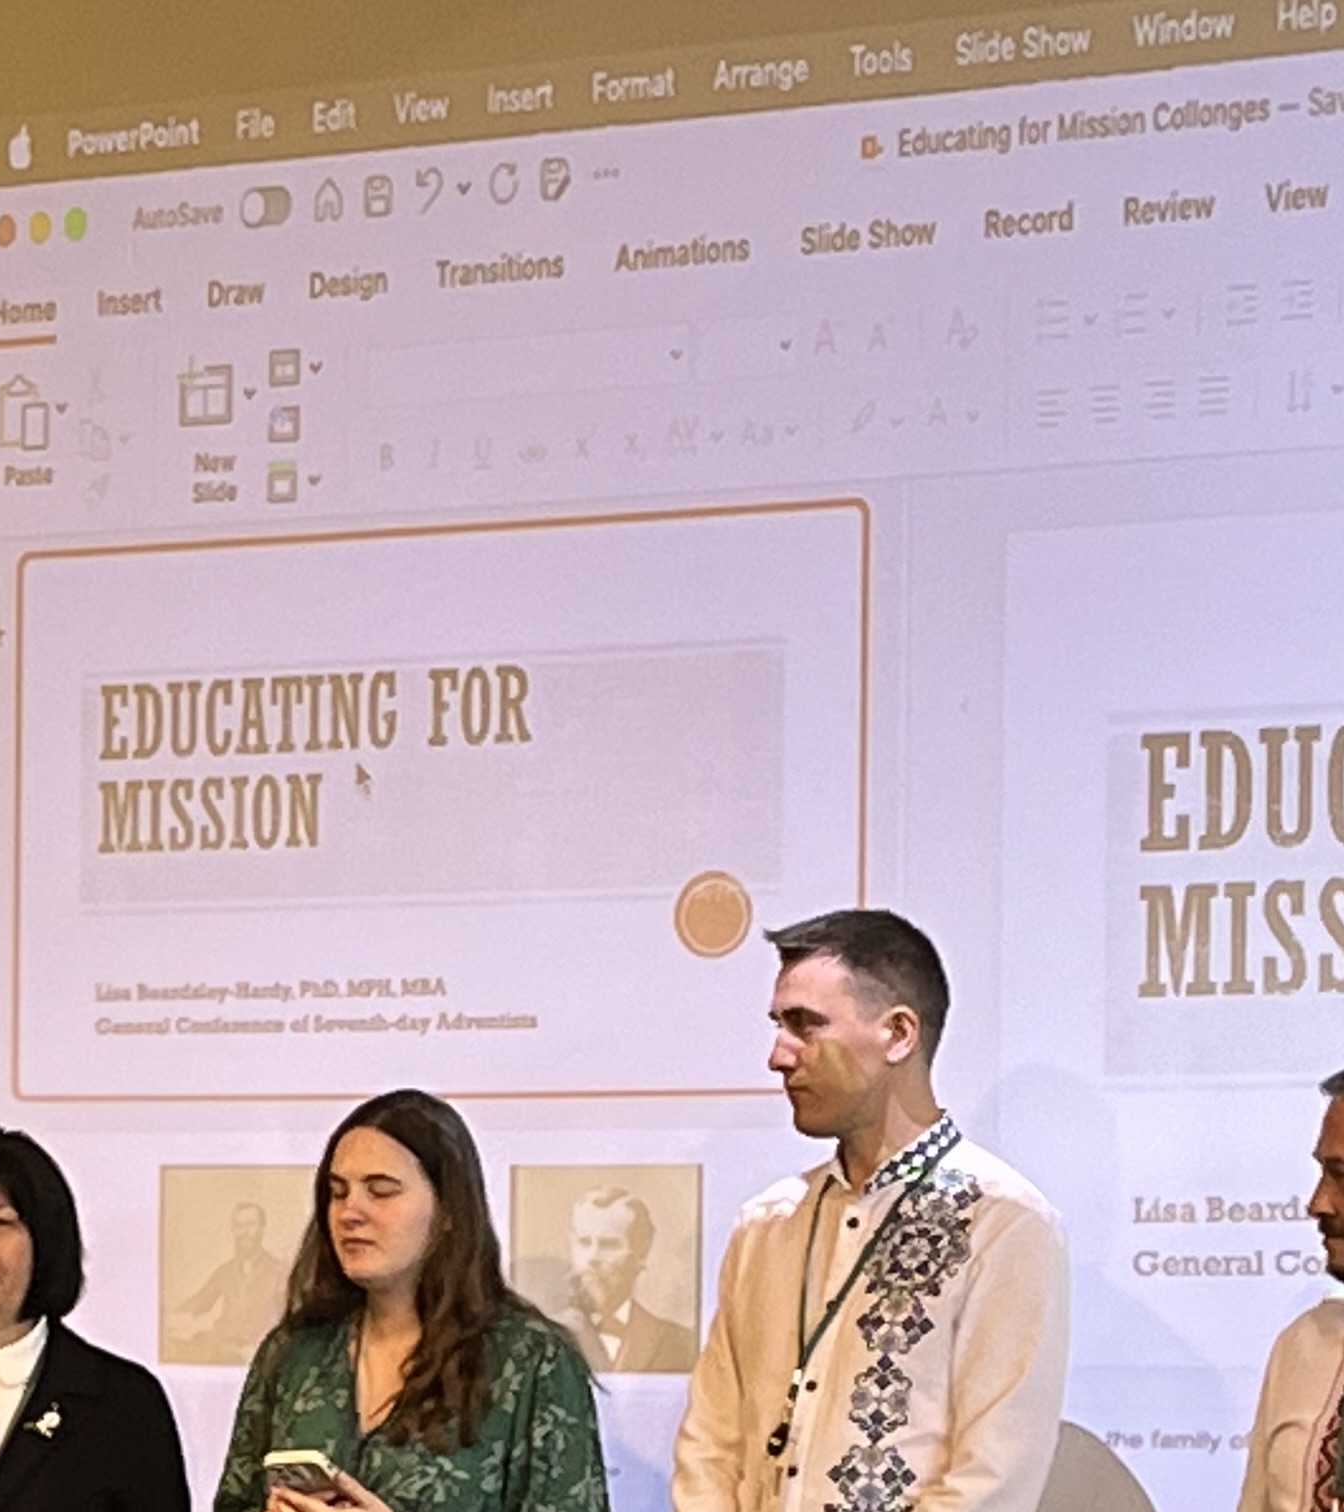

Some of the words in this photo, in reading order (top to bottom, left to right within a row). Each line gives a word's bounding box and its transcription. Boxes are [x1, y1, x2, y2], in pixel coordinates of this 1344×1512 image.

[1132, 11, 1235, 48] Window
[1276, 0, 1337, 33] Help
[849, 40, 913, 76] Tools
[956, 29, 1015, 66] Slide
[1022, 25, 1091, 59] Show
[591, 68, 675, 103] Format
[713, 56, 809, 91] Arrange
[393, 92, 449, 123] View
[487, 80, 553, 115] Insert
[236, 108, 275, 138] File
[312, 100, 357, 133] Edit
[898, 114, 1012, 158] Educating
[1019, 112, 1050, 145] for
[1058, 103, 1146, 141] Mission
[1154, 94, 1270, 133] Collonges
[67, 116, 200, 158] PowerPoint
[1123, 190, 1216, 227] Review
[1265, 179, 1329, 213] View
[132, 199, 224, 231] AutoSave
[984, 202, 1075, 239] Record
[615, 234, 751, 273] Animations
[800, 222, 861, 256] Slide
[867, 216, 936, 251] Show
[309, 268, 388, 302] Design
[436, 252, 564, 289] Transitions
[98, 287, 164, 316] Insert
[208, 279, 265, 308] Draw
[4, 465, 56, 487] Paste
[193, 452, 237, 473] New
[192, 480, 239, 503] Slide
[99, 671, 397, 761] EDUCATING
[429, 663, 533, 748] FOR
[97, 772, 323, 854] MISSION
[1133, 1196, 1197, 1224] Lisa
[1133, 1249, 1265, 1277] General
